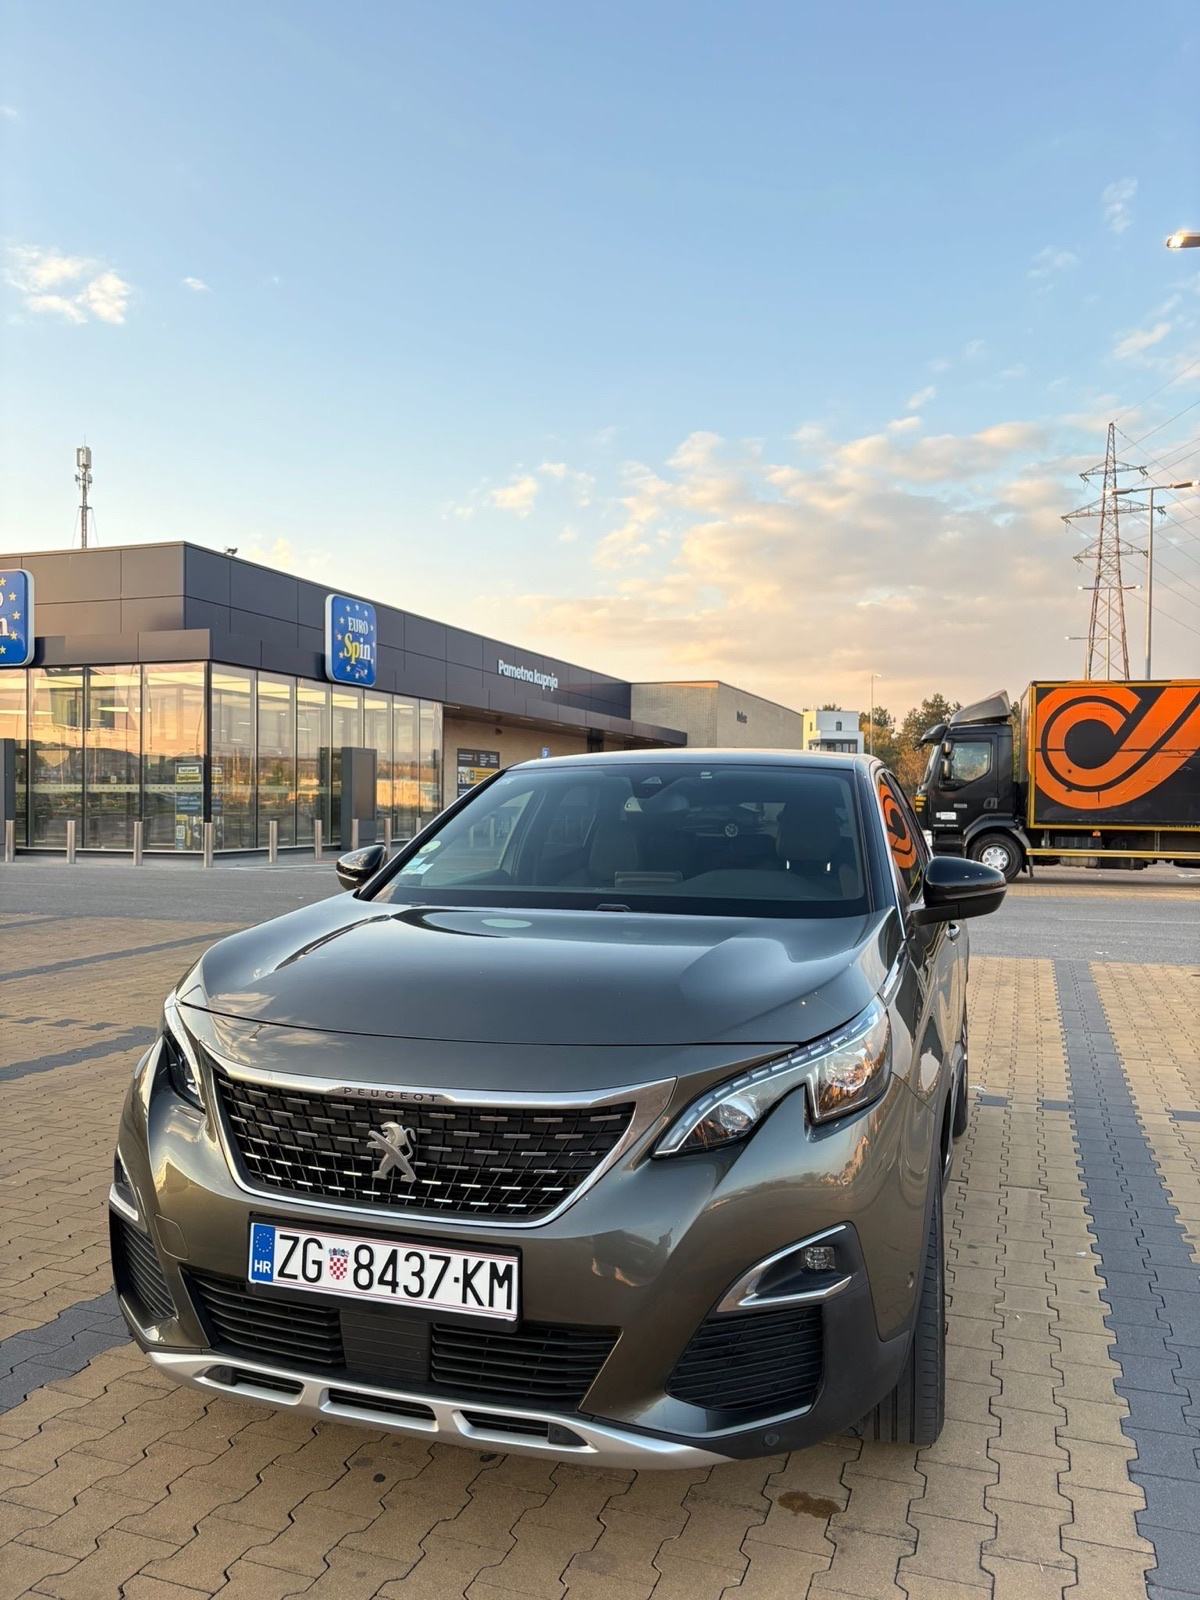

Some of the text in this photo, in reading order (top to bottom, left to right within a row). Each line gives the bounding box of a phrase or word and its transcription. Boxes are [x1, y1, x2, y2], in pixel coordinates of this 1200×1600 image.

[348, 617, 369, 635] EURO
[344, 633, 371, 664] Spin
[498, 659, 559, 692] Pametna kupnja
[343, 1087, 438, 1102] PEUGEOT
[254, 1259, 272, 1274] HR
[277, 1234, 324, 1283] ZG
